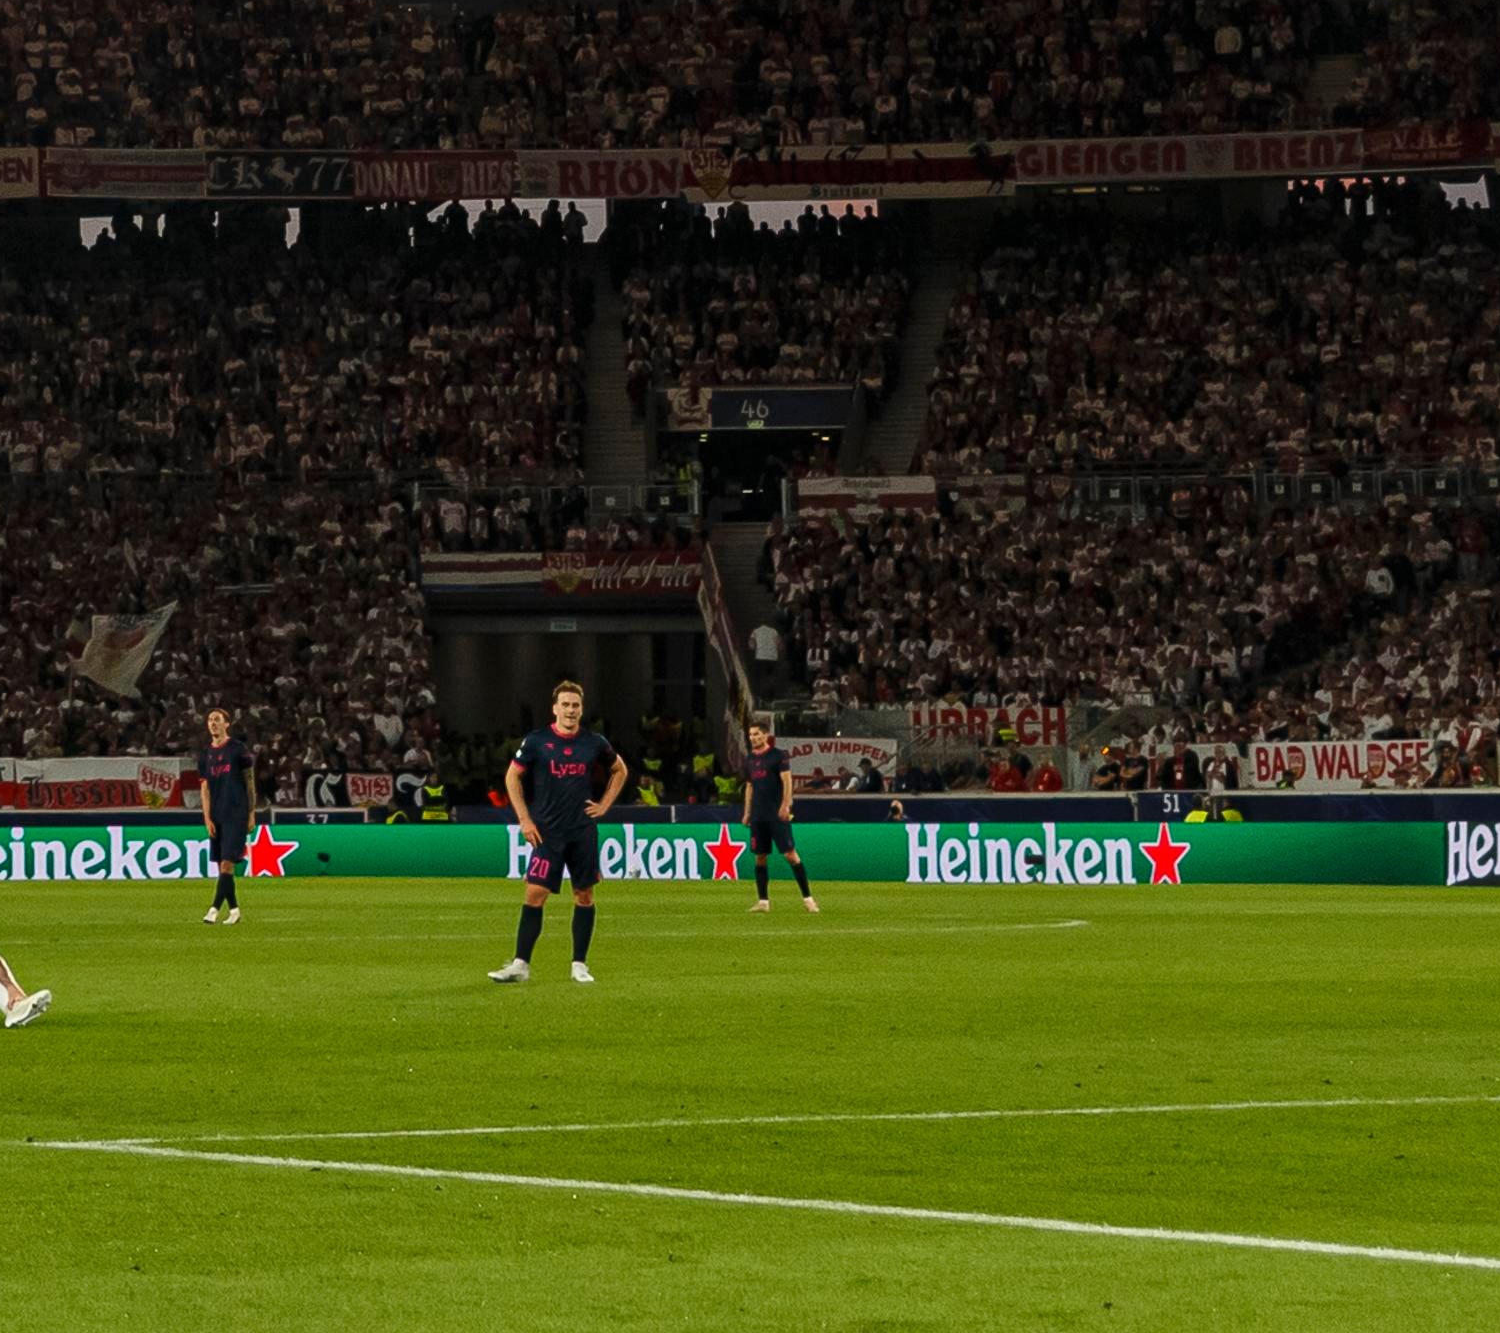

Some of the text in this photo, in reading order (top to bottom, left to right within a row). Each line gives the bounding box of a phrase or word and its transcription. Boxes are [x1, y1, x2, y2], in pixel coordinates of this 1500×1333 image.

[1018, 131, 1361, 178] GIENGEN BRENZ
[353, 160, 514, 199] DONAU RIES
[740, 397, 770, 420] 46
[1163, 793, 1181, 814] 51
[506, 822, 701, 880] Heken
[529, 856, 551, 880] 20
[905, 822, 1138, 885] Heineken
